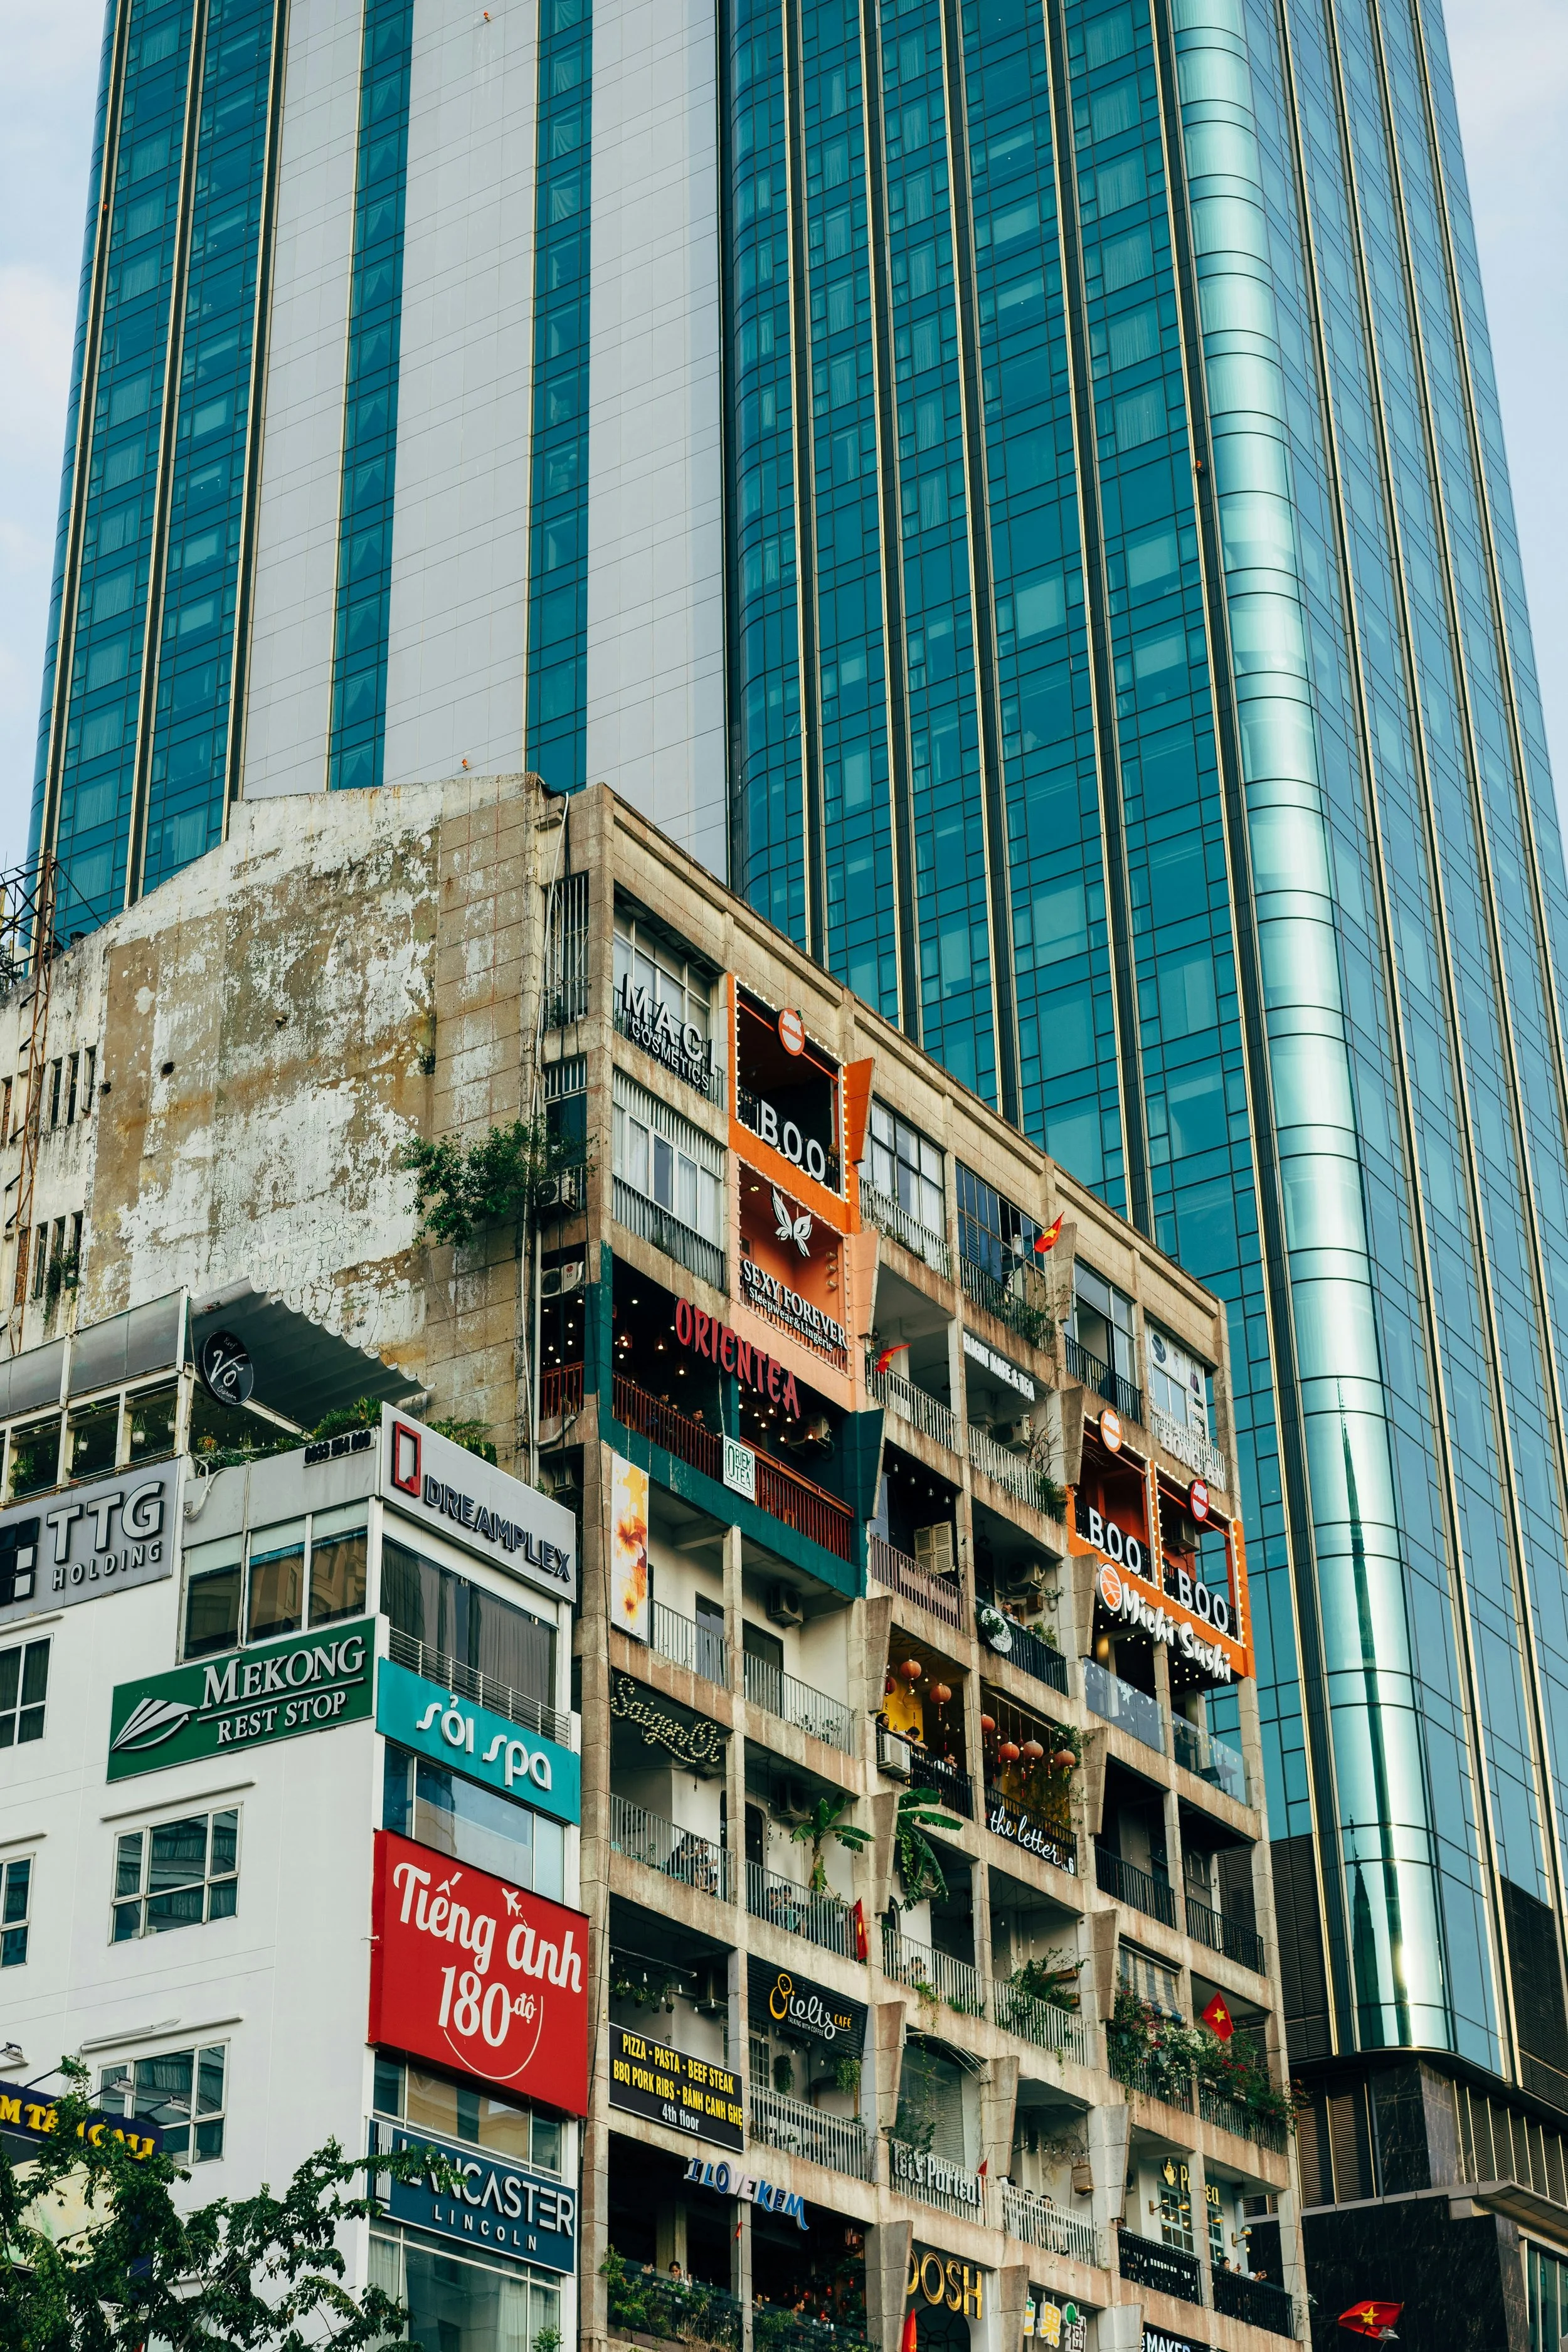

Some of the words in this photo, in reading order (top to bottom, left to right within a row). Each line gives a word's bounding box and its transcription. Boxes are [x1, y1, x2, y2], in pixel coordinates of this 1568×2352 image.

[623, 973, 716, 1076] MACI
[632, 1020, 709, 1091] COSMETICS
[761, 1099, 825, 1181] BOO
[742, 1259, 781, 1303] SEXY
[783, 1286, 848, 1350] FOREVER
[676, 1298, 800, 1419] ORIENTEA
[1018, 1373, 1035, 1402] TEA
[351, 1430, 371, 1451] 000
[46, 1481, 164, 1564] TTG
[424, 1474, 571, 1582] DREAMPLEX
[1089, 1507, 1142, 1575] BOO
[52, 1540, 162, 1591] HOLDING
[1121, 1582, 1175, 1647] Michi
[1179, 1621, 1231, 1683] Sushi
[1178, 1567, 1228, 1633] BOO
[199, 1636, 366, 1710] MEKONG
[216, 1707, 278, 1744] REST
[284, 1691, 347, 1727] STOP
[482, 1734, 552, 1791] spa
[990, 1806, 1015, 1836] the
[1018, 1814, 1062, 1865] letter
[1068, 1857, 1074, 1874] 6
[393, 1863, 497, 1975] Tiếng
[438, 1966, 511, 2047] 180
[511, 1993, 537, 2023] độ
[788, 2016, 802, 2027] TALKING
[802, 2023, 810, 2031] WITH
[811, 2026, 824, 2037] COFFEE
[834, 2013, 852, 2028] CAFÉ
[613, 2059, 630, 2086] BBQ
[632, 2067, 655, 2093] PORK
[656, 2075, 675, 2100] RIBS
[682, 2084, 704, 2112] BÁNH
[705, 2095, 726, 2121] CANH
[728, 2103, 743, 2131] GHẸ
[622, 2033, 647, 2061] PIZZA
[654, 2046, 681, 2074] PASTA
[687, 2059, 707, 2084] BEEF
[709, 2067, 734, 2095] STEAK
[662, 2104, 677, 2123] 4th
[679, 2109, 699, 2131] floor
[684, 2157, 702, 2181] I
[699, 2159, 756, 2202] LOVE
[753, 2179, 810, 2230] KEM
[433, 2205, 537, 2250] LINCOLN
[1147, 2331, 1191, 2352] MAK
